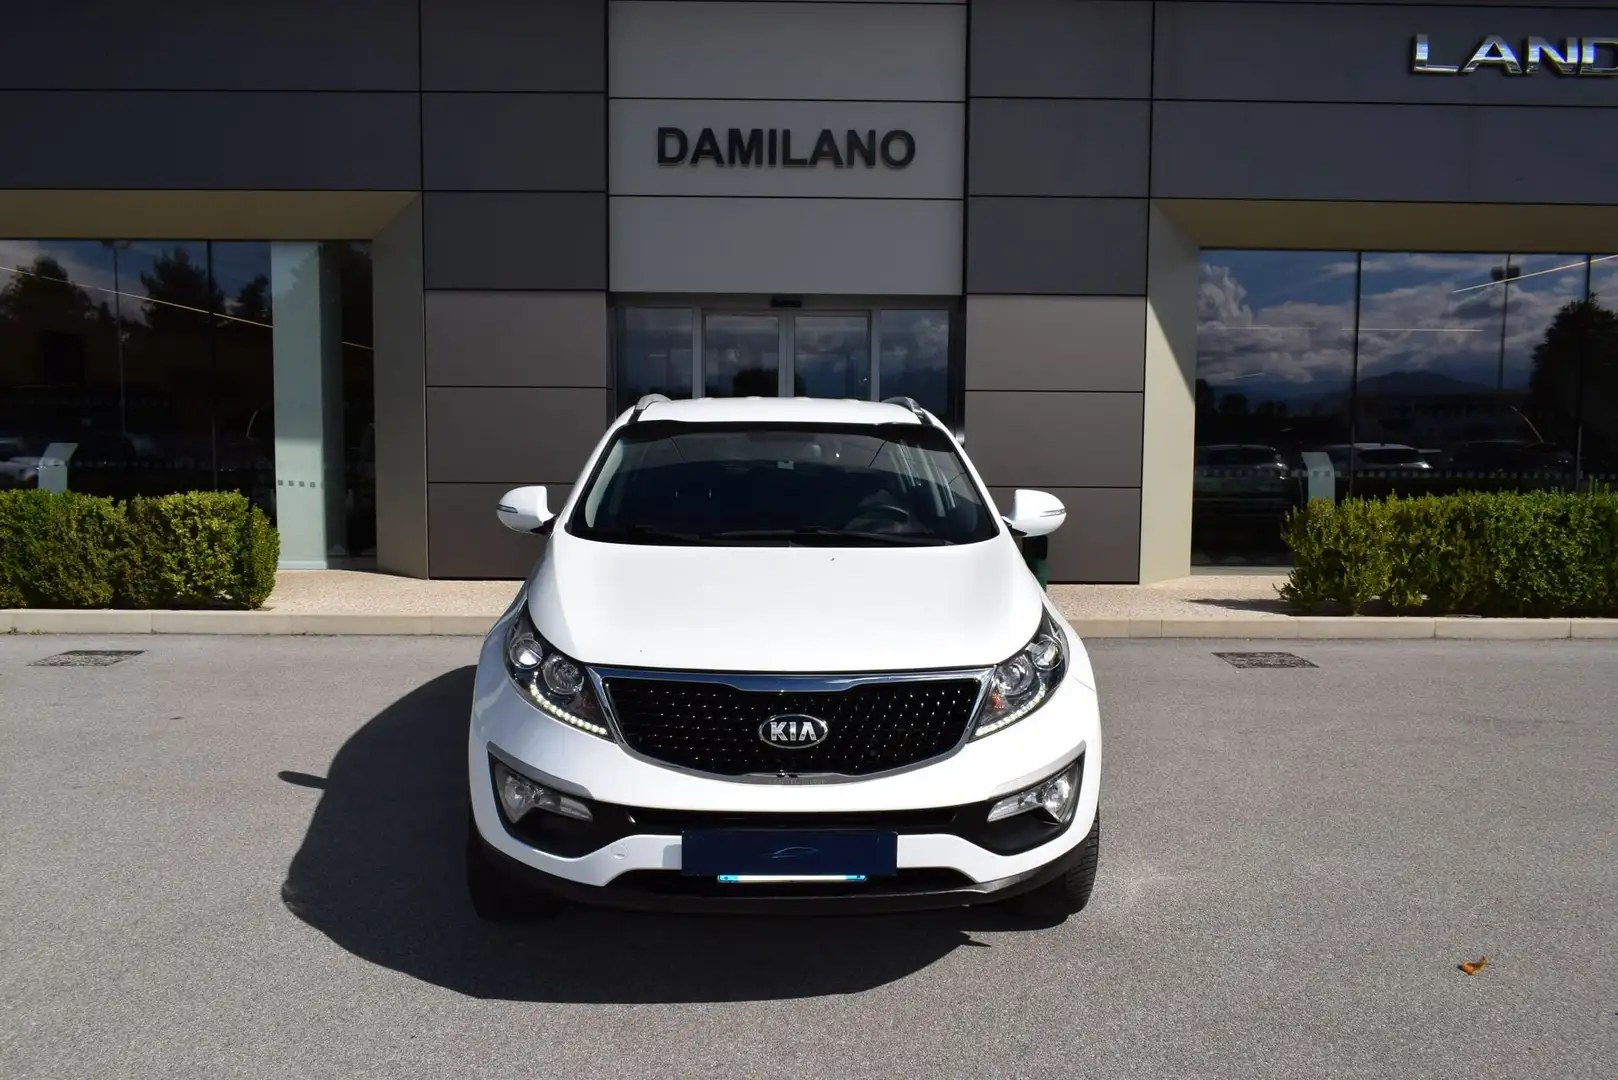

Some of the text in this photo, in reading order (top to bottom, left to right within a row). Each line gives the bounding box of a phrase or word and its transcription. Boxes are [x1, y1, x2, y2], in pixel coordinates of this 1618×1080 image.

[1413, 32, 1618, 76] LAND
[657, 127, 916, 168] DAMILANO
[769, 721, 818, 741] KIA
